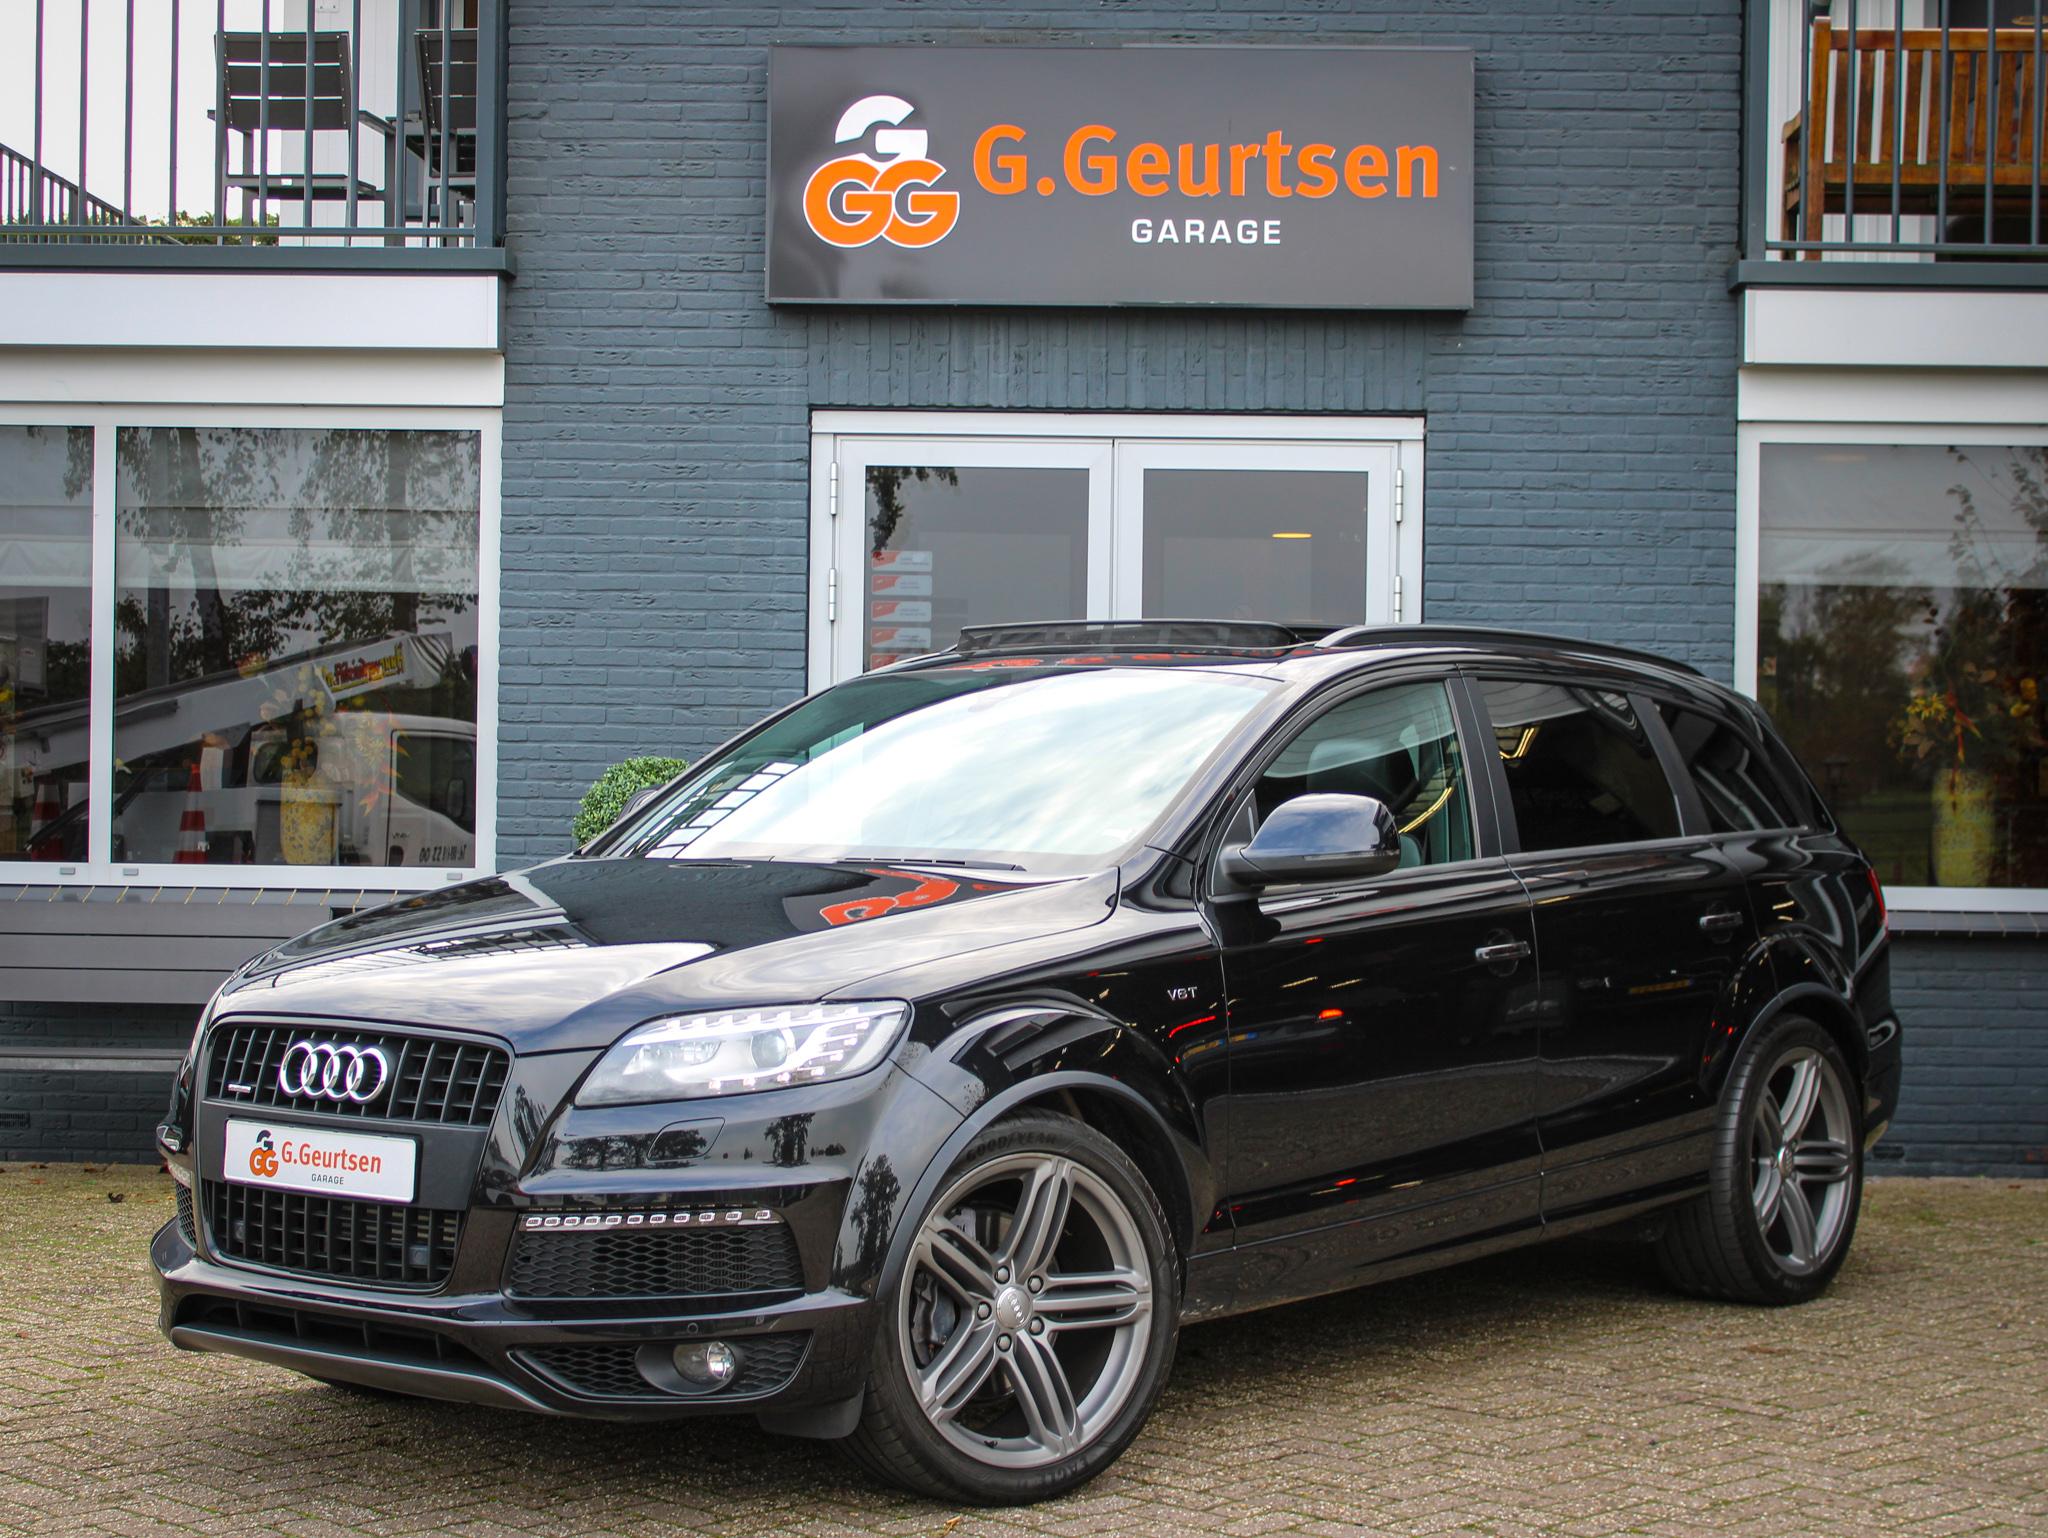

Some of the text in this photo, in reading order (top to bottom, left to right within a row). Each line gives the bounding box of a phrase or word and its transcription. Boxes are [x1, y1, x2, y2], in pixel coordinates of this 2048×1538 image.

[973, 124, 1439, 199] G.Geurtsen
[1131, 219, 1282, 244] GARAGE
[281, 1141, 382, 1174] G.Geurtsen
[311, 1173, 344, 1185] GARAGE
